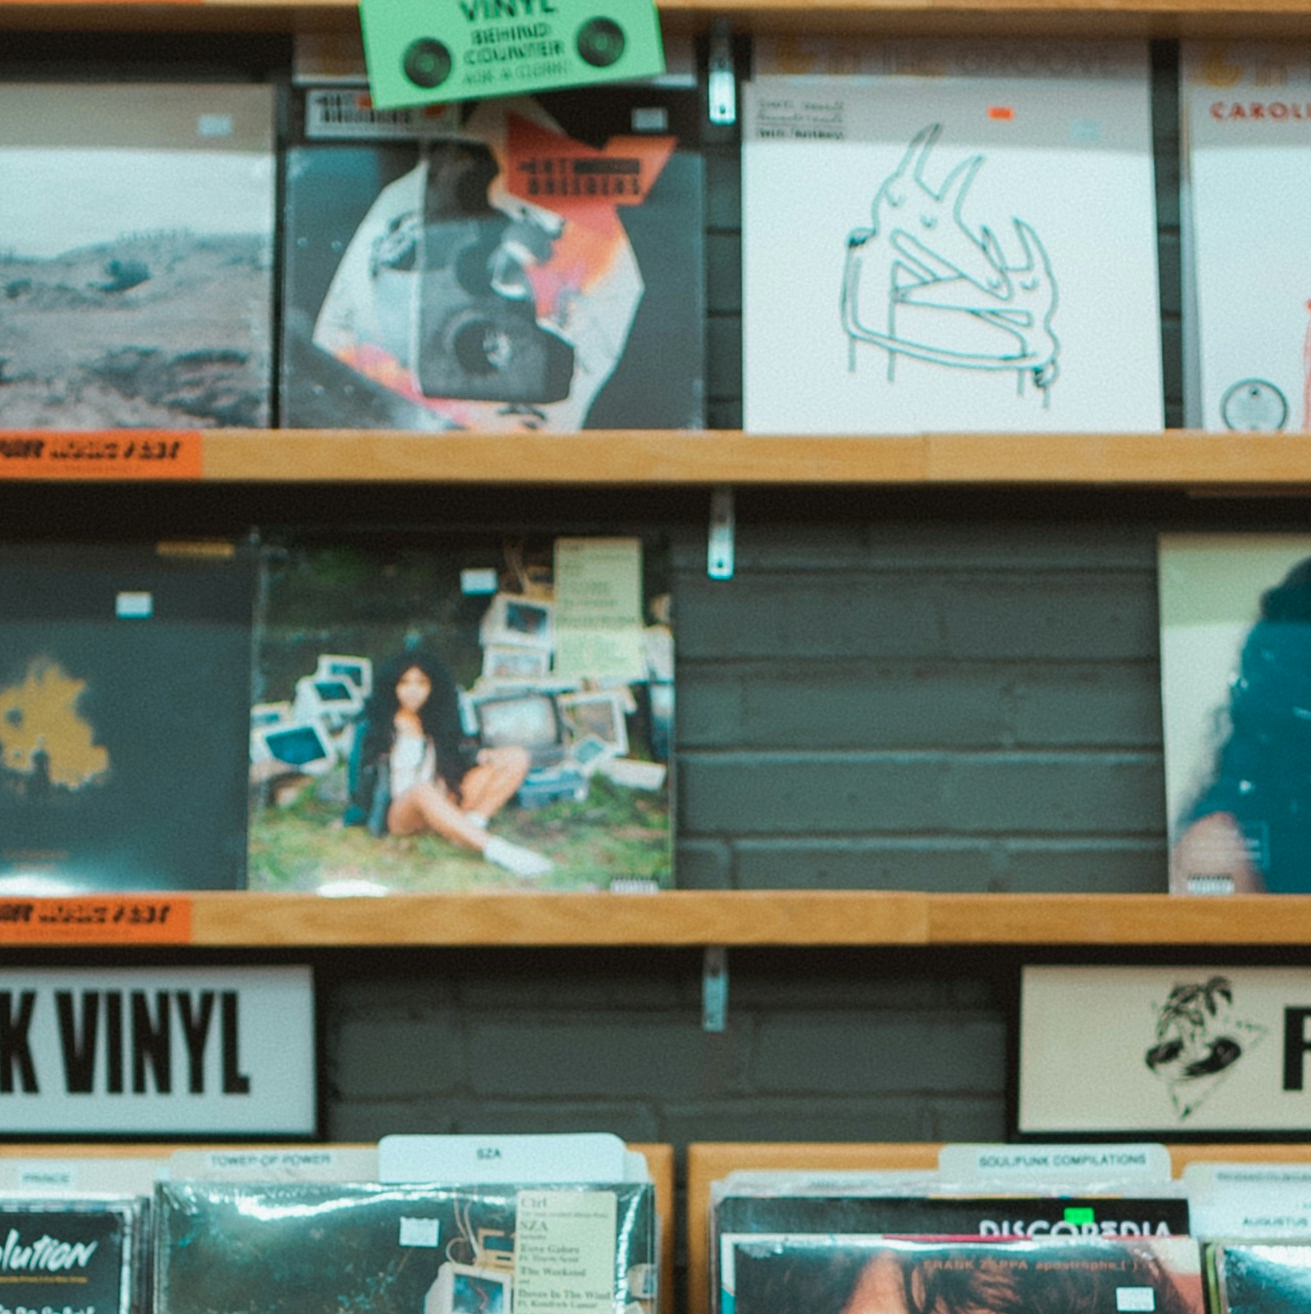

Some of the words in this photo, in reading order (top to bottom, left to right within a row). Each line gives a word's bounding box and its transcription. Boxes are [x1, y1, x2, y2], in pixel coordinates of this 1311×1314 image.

[472, 23, 552, 45] BEHIND
[463, 41, 565, 64] COUNTER
[54, 988, 251, 1094] VINYL
[476, 1147, 502, 1160] SZA
[1053, 1153, 1147, 1167] COMPILATIONS
[22, 1171, 71, 1185] PRINCE
